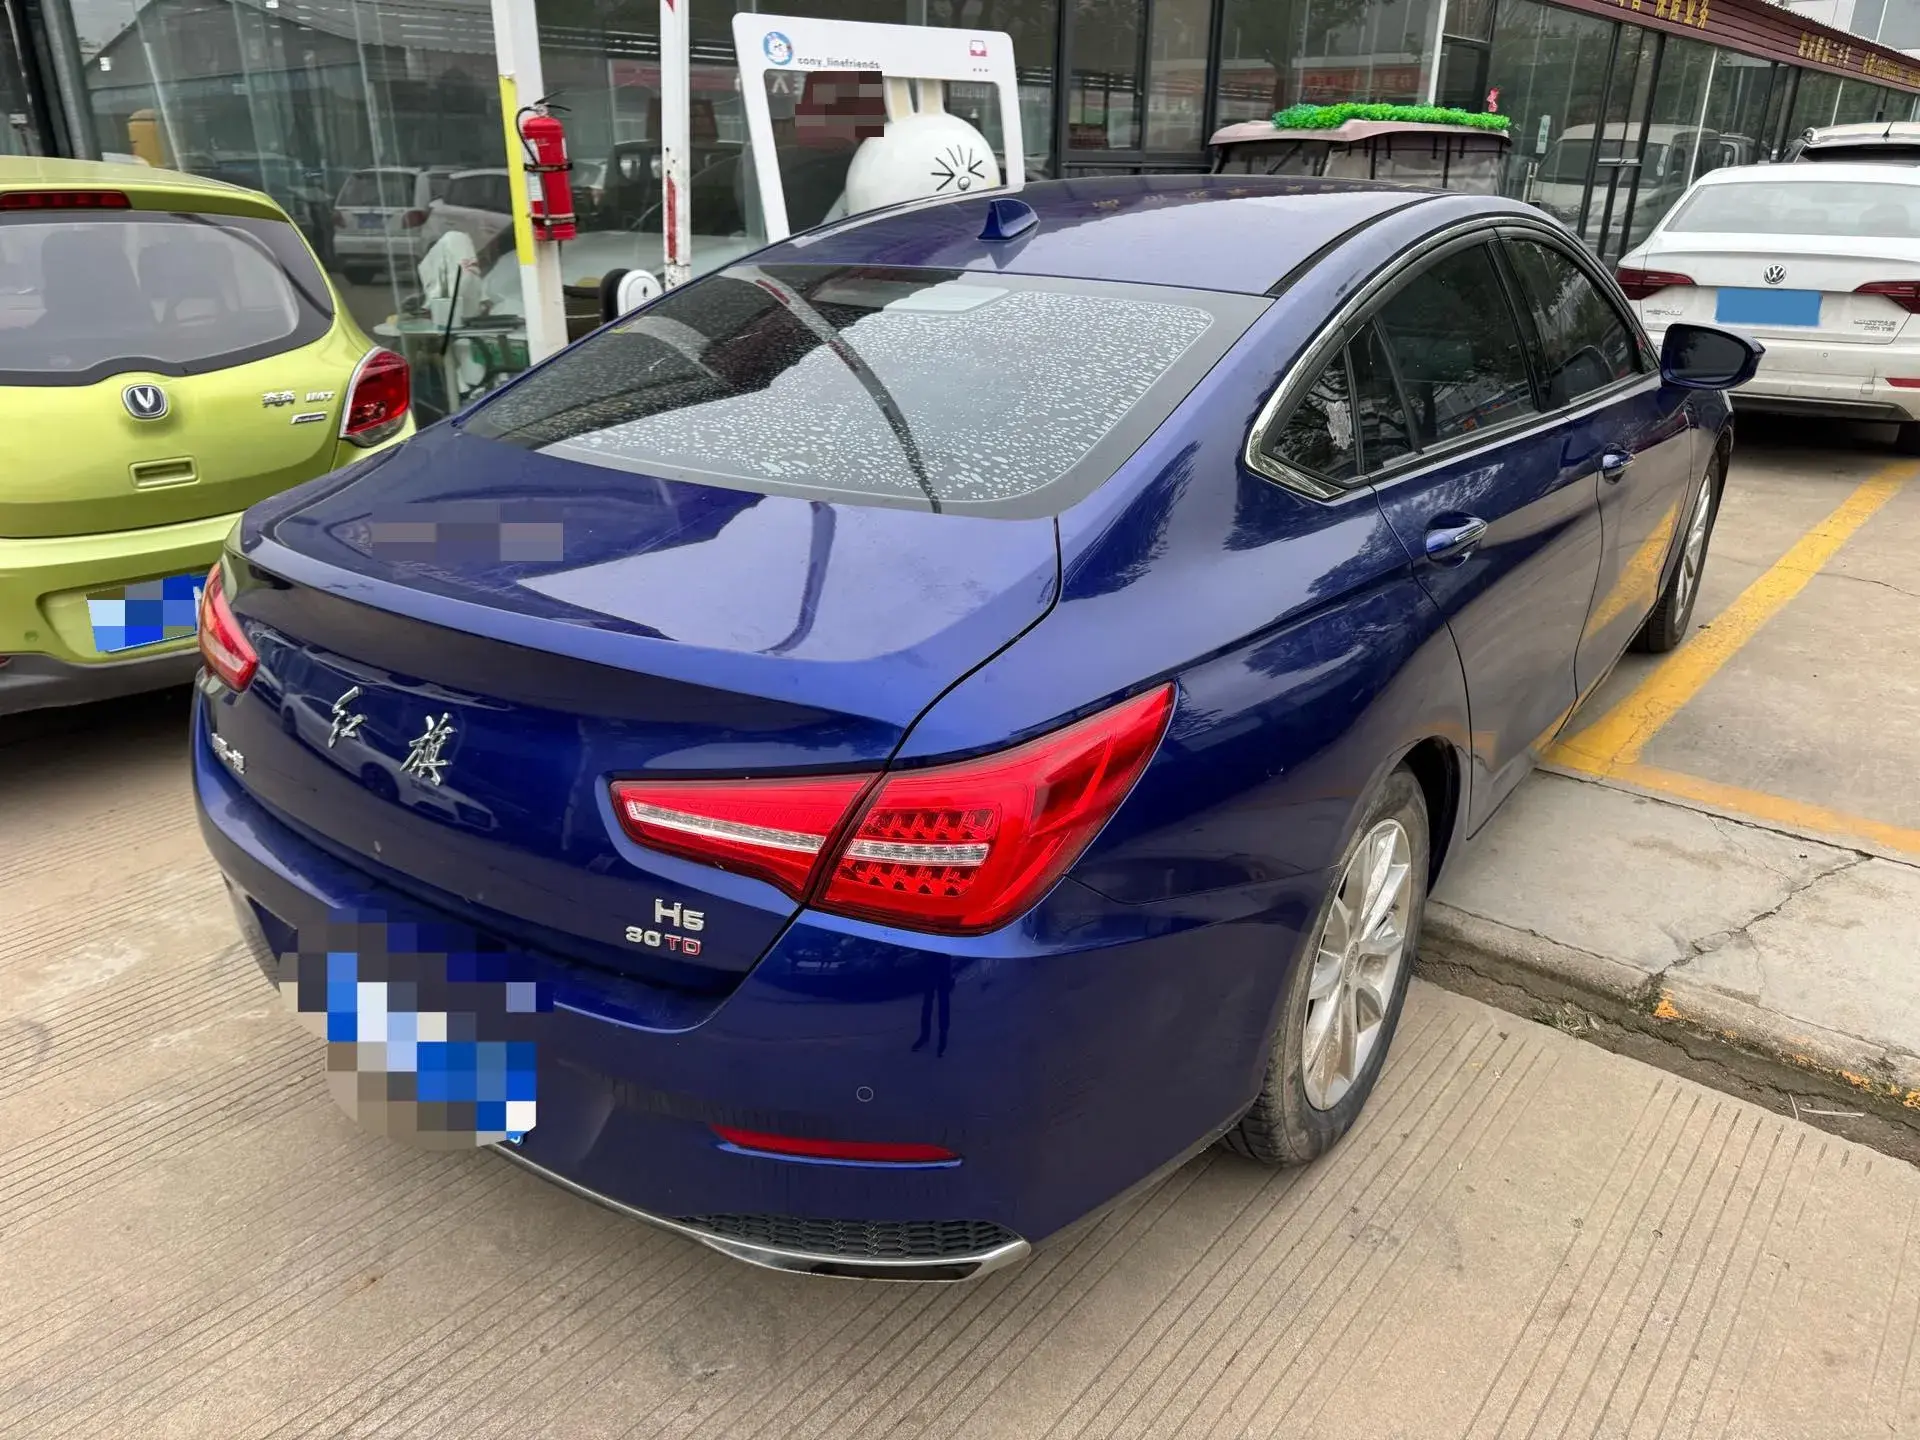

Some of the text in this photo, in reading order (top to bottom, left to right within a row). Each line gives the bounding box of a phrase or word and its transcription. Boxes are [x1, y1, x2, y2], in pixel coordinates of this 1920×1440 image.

[327, 685, 457, 787] 红旗
[654, 898, 705, 932] H5
[625, 925, 701, 956] 30TD
